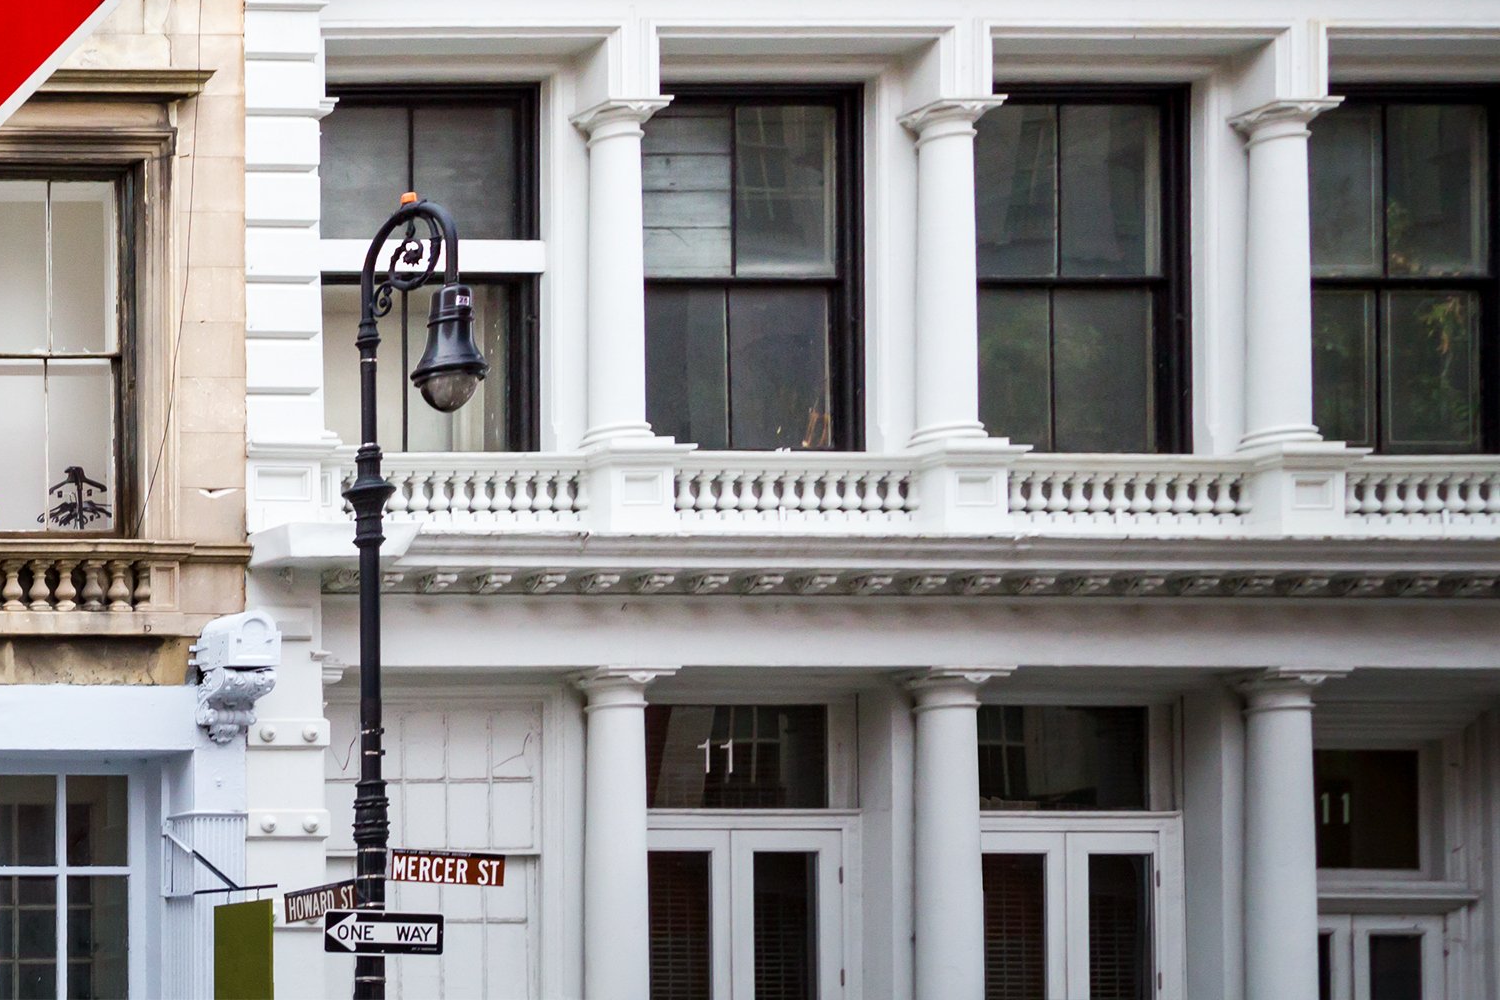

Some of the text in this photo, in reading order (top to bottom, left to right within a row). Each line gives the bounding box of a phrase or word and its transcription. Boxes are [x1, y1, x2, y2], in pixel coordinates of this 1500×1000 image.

[697, 738, 733, 773] 11
[1321, 792, 1349, 824] 11
[393, 856, 500, 885] MERCER ST
[289, 891, 335, 920] HOWARD
[341, 885, 354, 909] ST
[337, 925, 433, 942] ONE WAY
